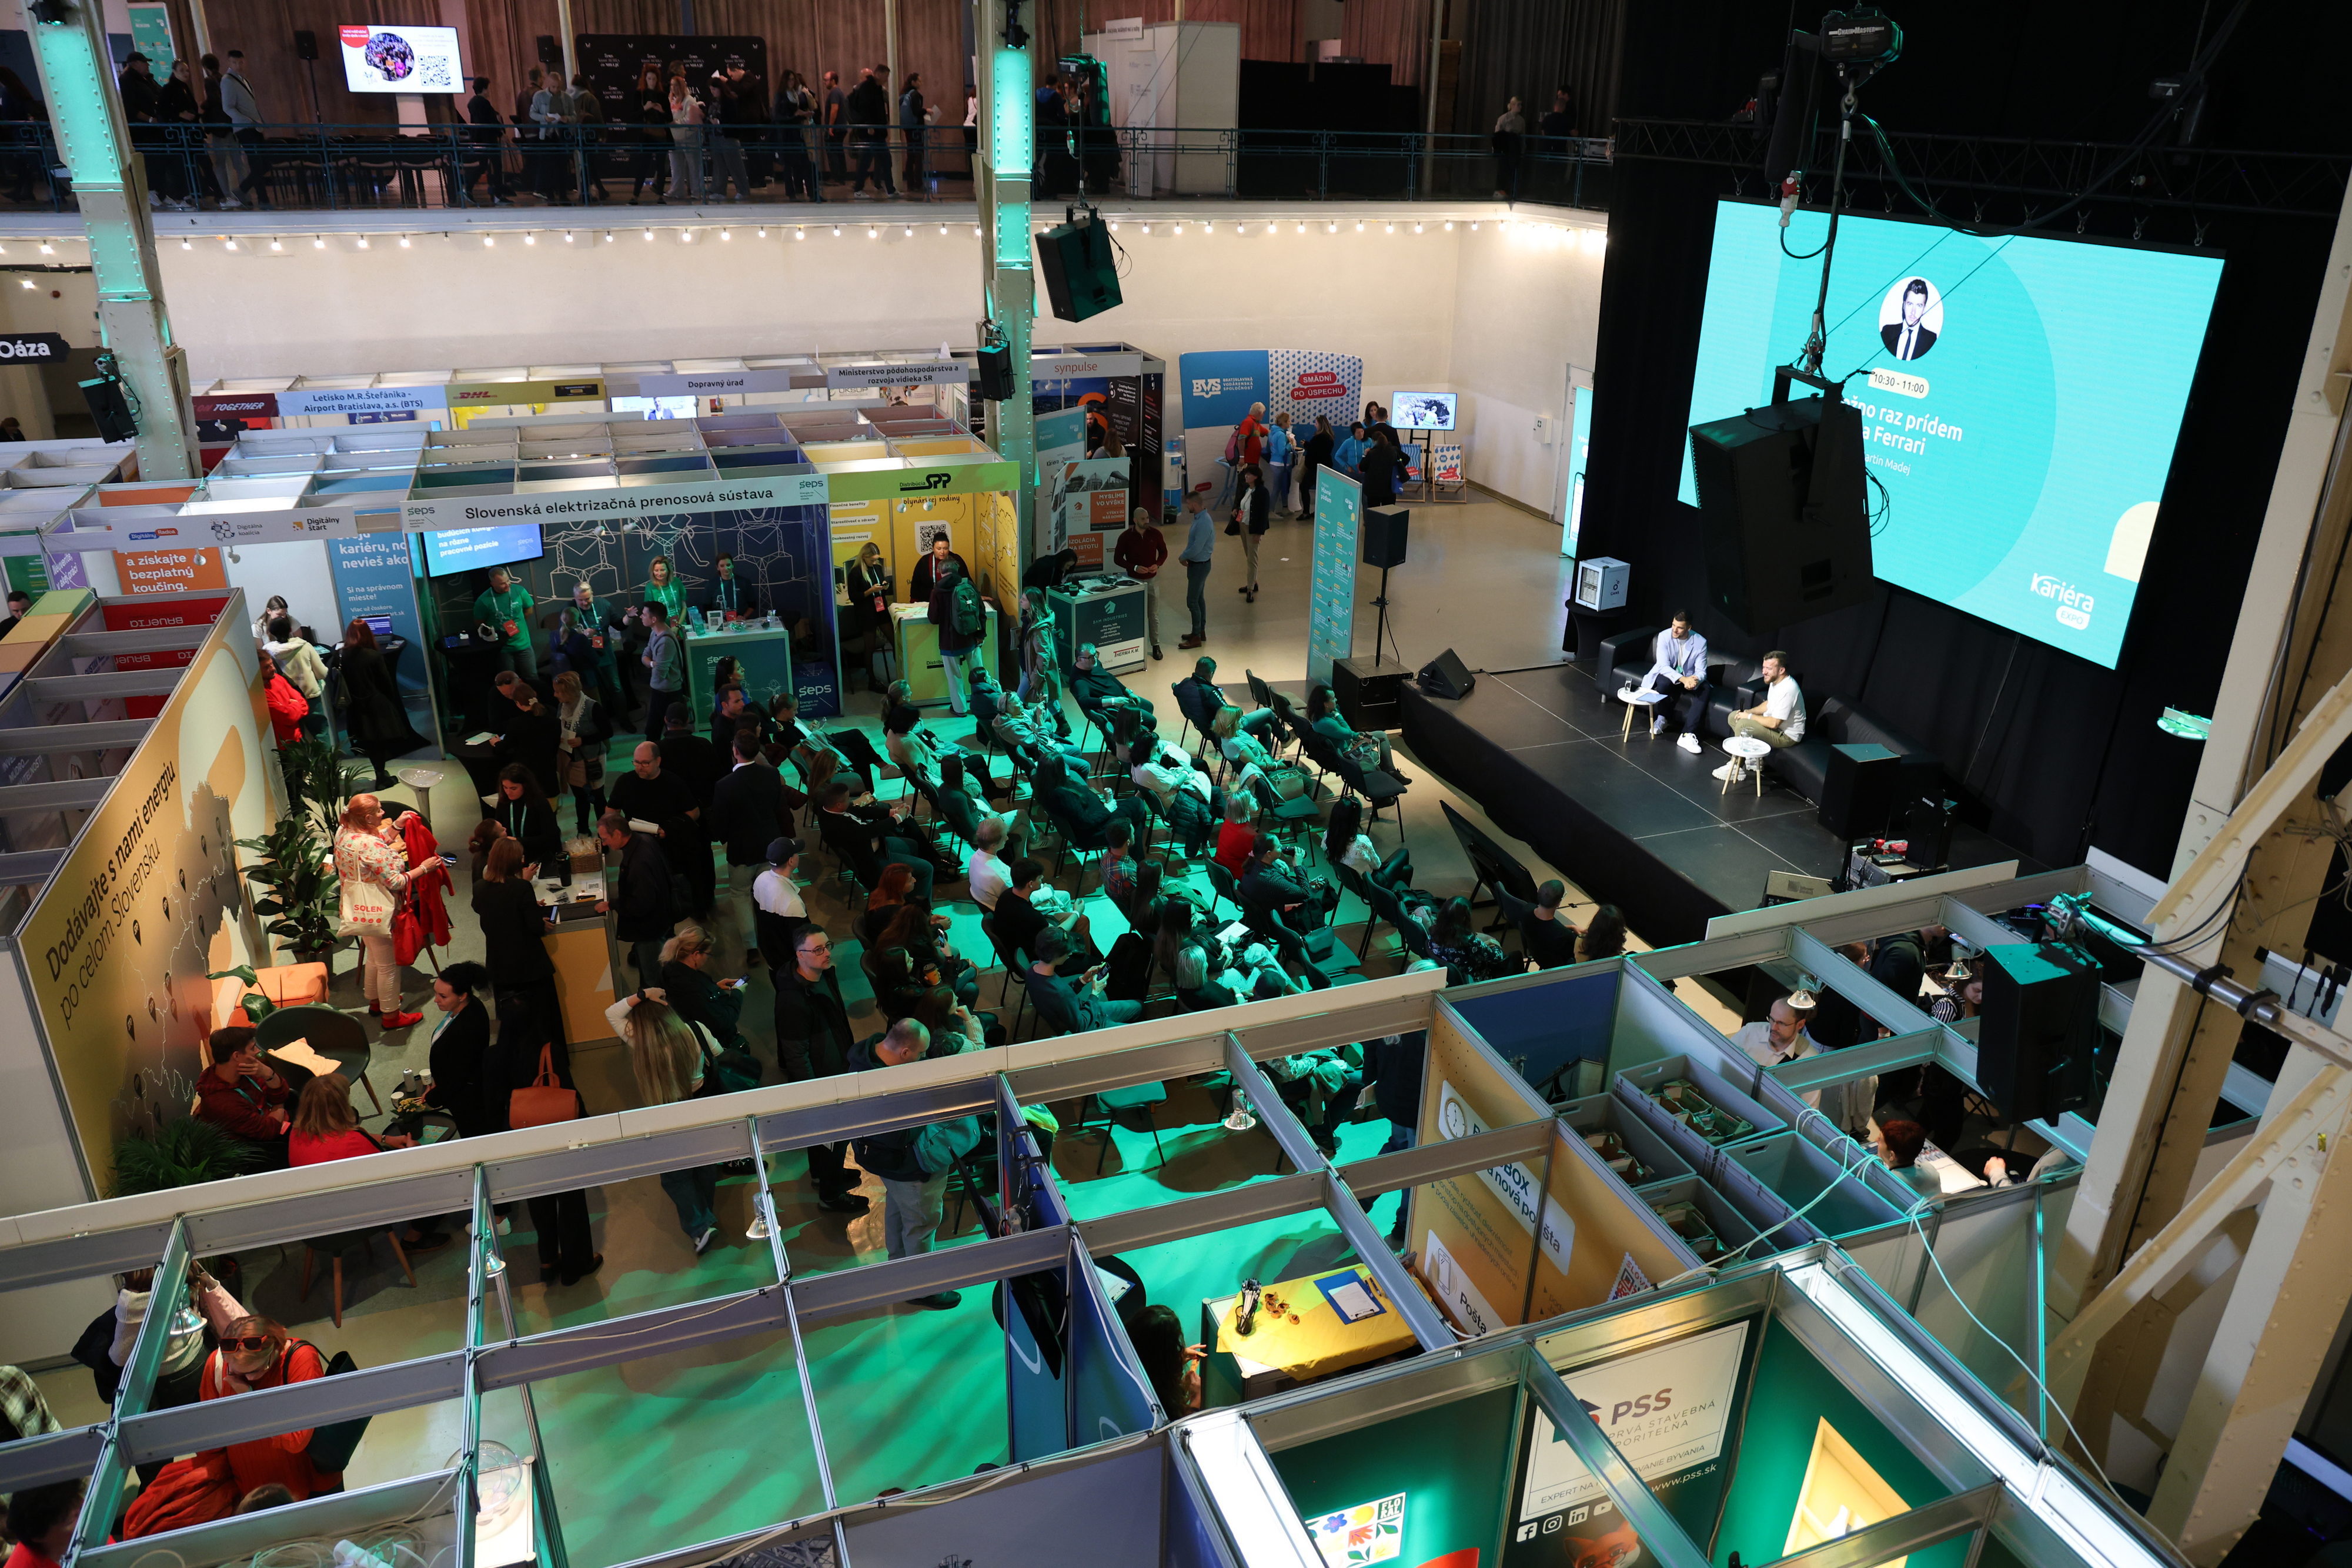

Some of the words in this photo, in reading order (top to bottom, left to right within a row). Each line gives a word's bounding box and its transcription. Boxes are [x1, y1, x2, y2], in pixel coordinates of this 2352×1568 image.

[0, 340, 51, 358] Oáza
[838, 367, 884, 376] Ministerstvo
[886, 365, 952, 375] pôdohospodárstva
[1055, 362, 1098, 374] synpulse
[688, 379, 724, 389] Dopravný
[1192, 378, 1222, 393] BVS
[1302, 374, 1332, 383] SMÄDNÍ
[1873, 374, 1895, 387] 10:30
[1902, 380, 1925, 393] 11:00
[459, 391, 490, 399] DHL
[1307, 387, 1343, 396] ÚSPECHU
[213, 402, 265, 412] TOGETHER
[304, 404, 335, 413] Airport
[338, 402, 383, 411] Bratislava,
[400, 400, 423, 409] (BTS)
[1879, 407, 1904, 426] raz
[1905, 413, 1963, 442] prídem
[1863, 425, 1870, 440] a
[1873, 424, 1926, 456] Ferrari
[1865, 455, 1885, 470] artin
[1885, 459, 1910, 476] Madej
[465, 503, 542, 519] Slovenská
[545, 497, 636, 514] elektrizačná
[640, 492, 715, 510] prenosová
[719, 489, 773, 502] sústava
[307, 516, 339, 526] Digitálny
[338, 542, 390, 554] kariéru,
[138, 554, 187, 566] získajte
[342, 556, 384, 569] nevieš
[386, 554, 408, 566] ako
[129, 567, 195, 580] bezplatný
[132, 582, 188, 593] koučing.
[366, 584, 403, 593] správnom
[2029, 572, 2094, 613] Kariéra
[348, 593, 377, 602] mieste!
[1102, 613, 1128, 623] INDUSTRIES
[2060, 610, 2084, 624] EXPO
[1114, 648, 1131, 657] THERMA
[45, 872, 109, 982] Dodávajte
[108, 858, 118, 881] s
[115, 808, 144, 871] nami
[142, 760, 176, 825] energiu
[353, 904, 383, 912] SOLEN
[60, 983, 79, 1032] po
[79, 918, 115, 989] celom
[111, 837, 161, 928] Slovensku
[1495, 1172, 1520, 1208] nová
[1460, 1291, 1487, 1334] Pošta
[1611, 1388, 1673, 1426] PSS
[1609, 1422, 1642, 1440] PRVÁ
[1648, 1398, 1715, 1428] STAVEBNÁ
[1615, 1419, 1689, 1448] PORITEĽŇA
[1540, 1486, 1578, 1505] EXPERT
[1666, 1444, 1705, 1464] BÝVANIA
[1651, 1462, 1717, 1493] www.pss.sk
